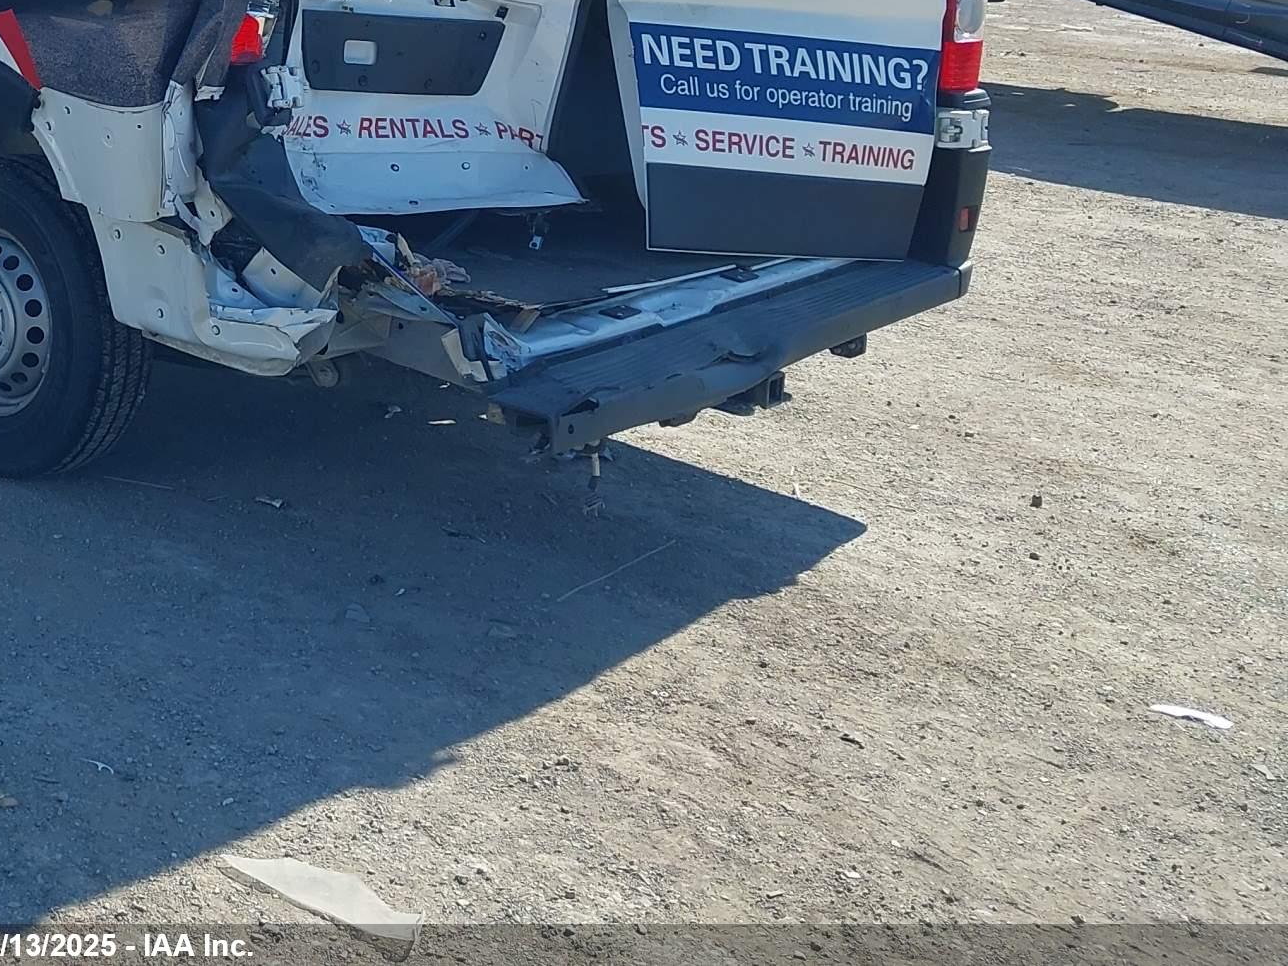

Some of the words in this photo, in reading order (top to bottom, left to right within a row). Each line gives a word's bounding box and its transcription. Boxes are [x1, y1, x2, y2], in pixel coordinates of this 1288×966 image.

[641, 34, 741, 71] NEED
[744, 43, 928, 90] TRAINING?
[660, 74, 699, 96] Call
[705, 83, 729, 99] us
[735, 82, 760, 101] for
[766, 87, 843, 111] operator
[848, 92, 913, 122] training
[357, 117, 469, 139] RENTALS
[695, 129, 795, 159] SERVICE
[819, 140, 915, 170] TRAINING
